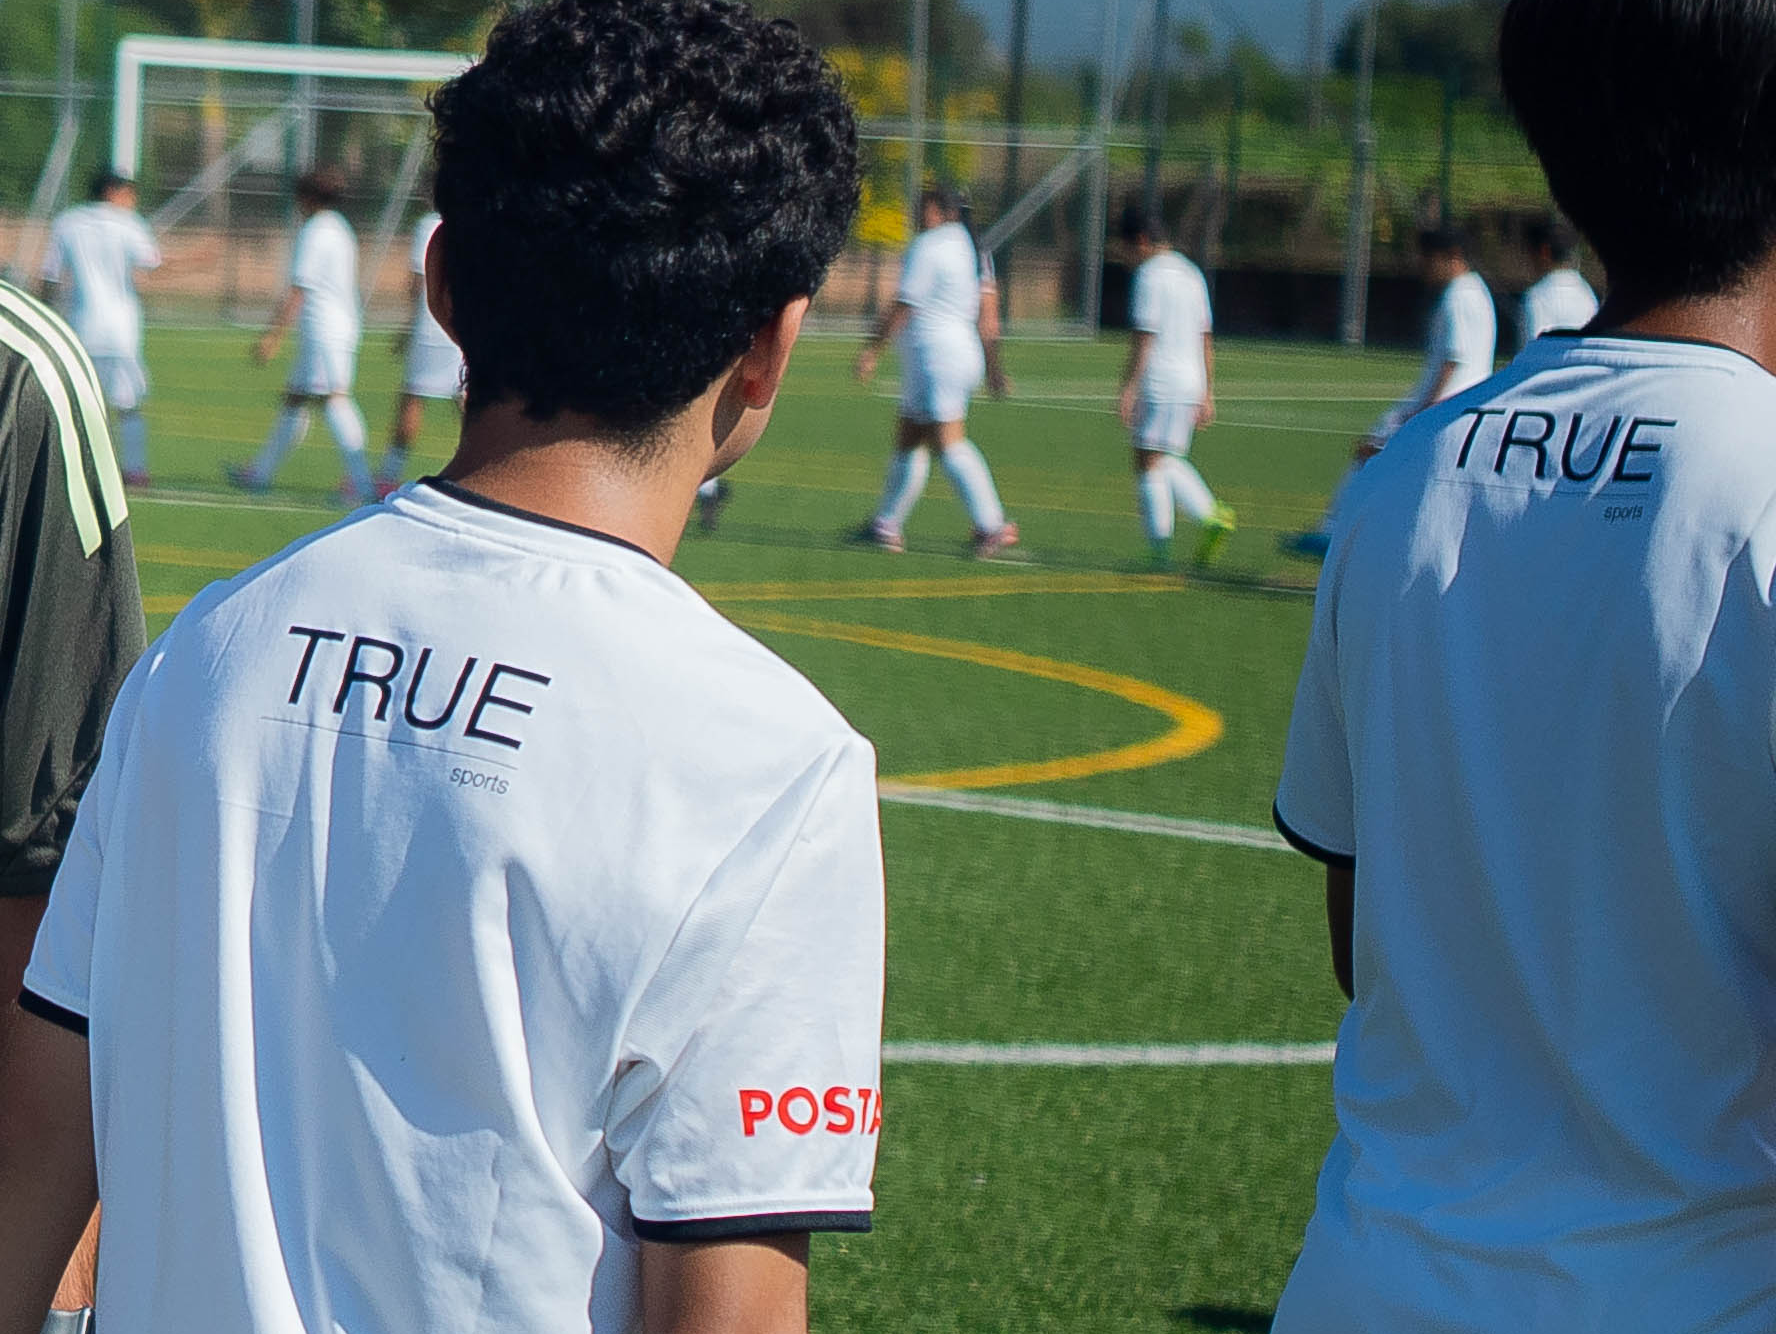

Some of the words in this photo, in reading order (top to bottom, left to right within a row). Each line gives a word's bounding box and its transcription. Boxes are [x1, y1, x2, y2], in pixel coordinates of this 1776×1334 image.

[1456, 407, 1677, 483] TRUE
[288, 626, 552, 750] TRUE
[449, 767, 510, 796] sports
